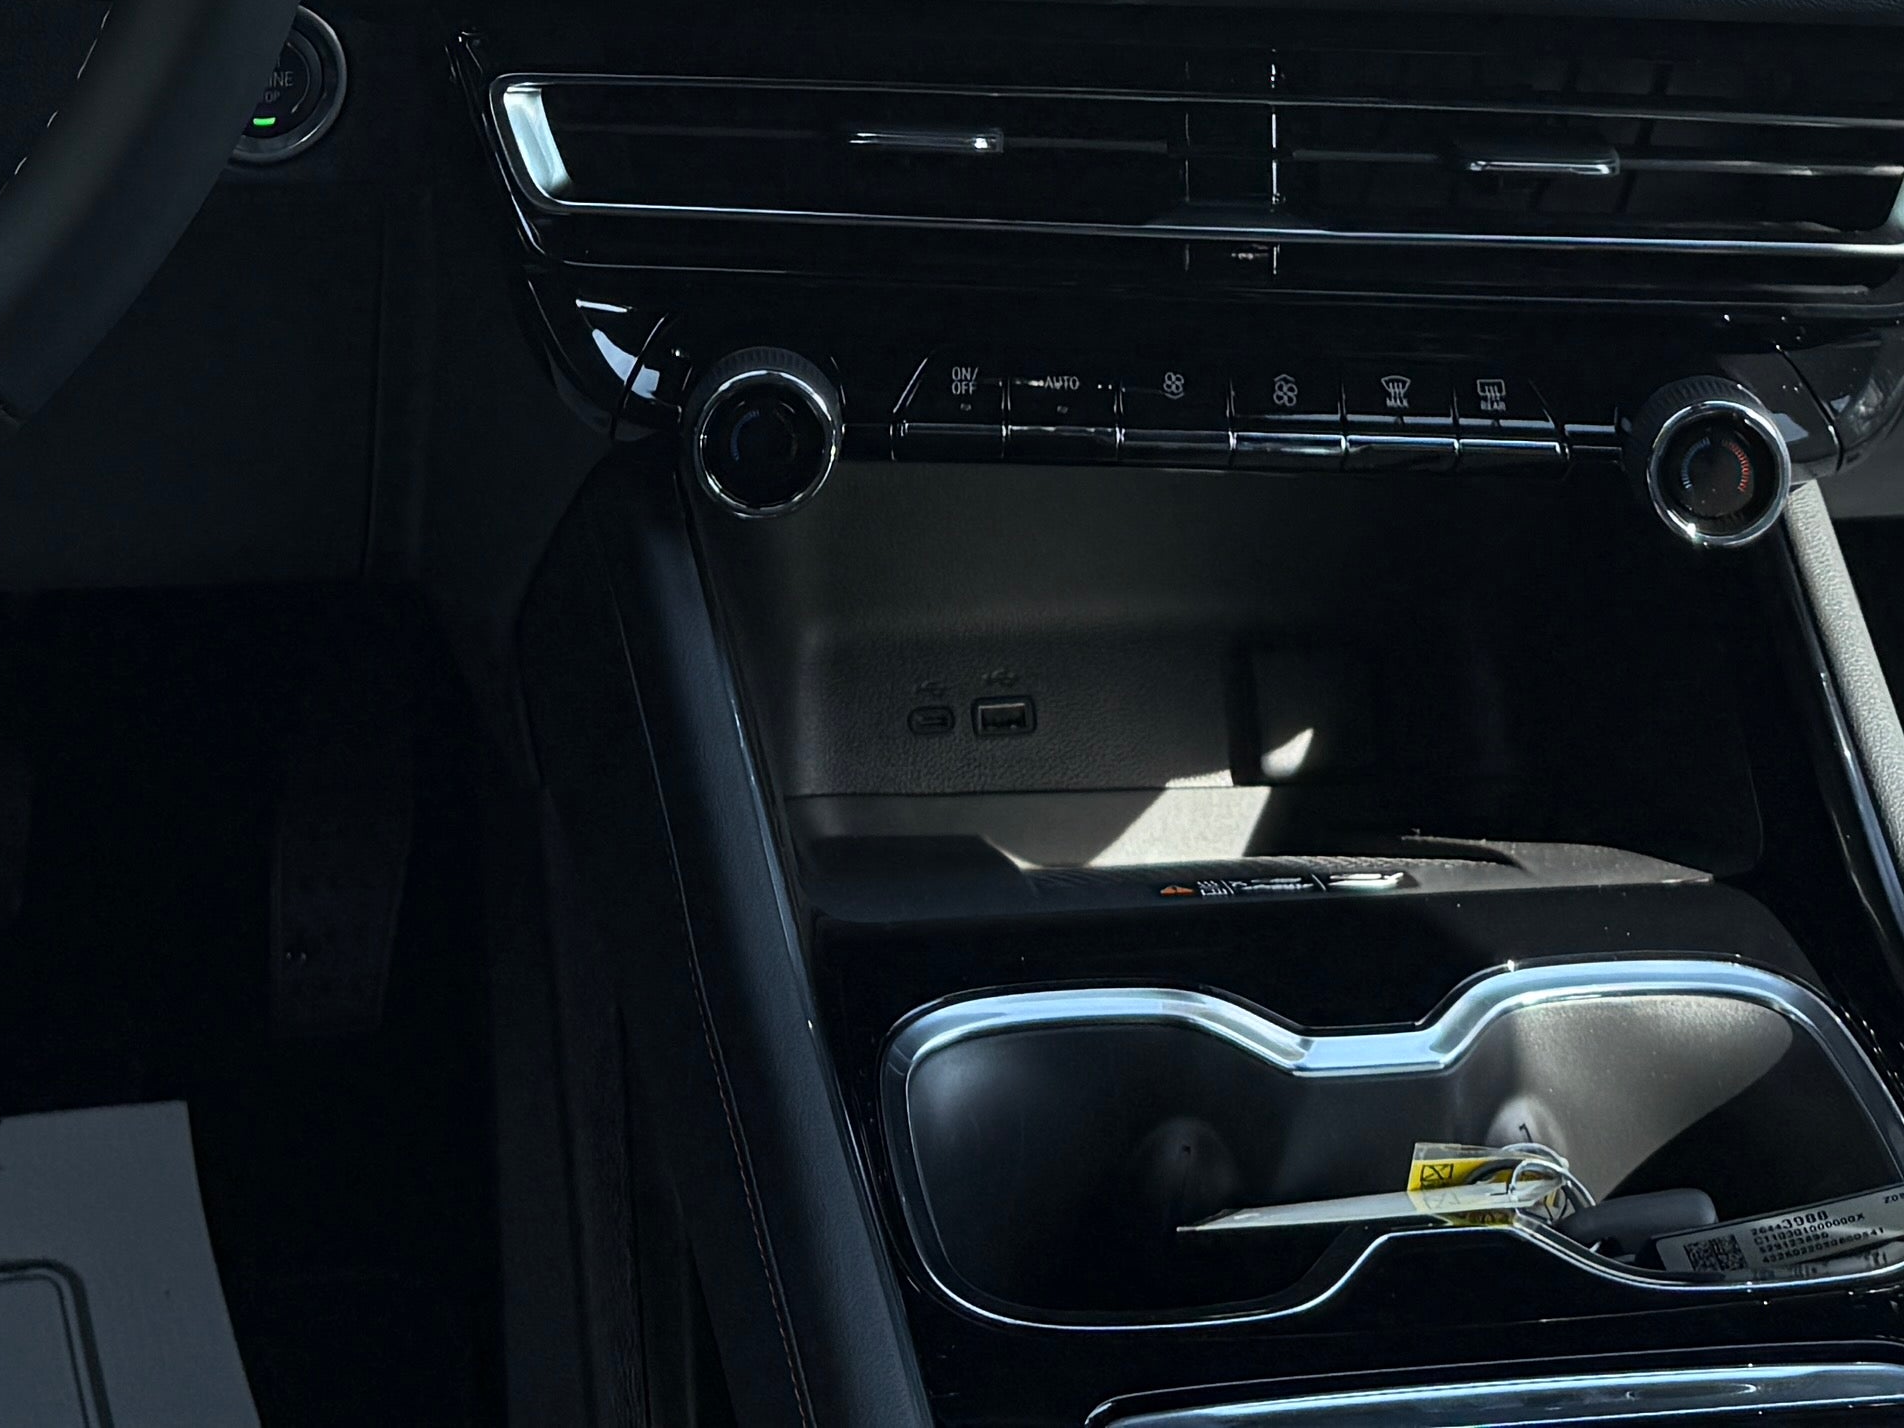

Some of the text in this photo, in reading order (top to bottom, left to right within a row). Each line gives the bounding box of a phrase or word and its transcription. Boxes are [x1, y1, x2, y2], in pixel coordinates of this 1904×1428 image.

[951, 366, 979, 382] ON/
[951, 381, 977, 395] OFF
[1045, 375, 1080, 391] AUTO
